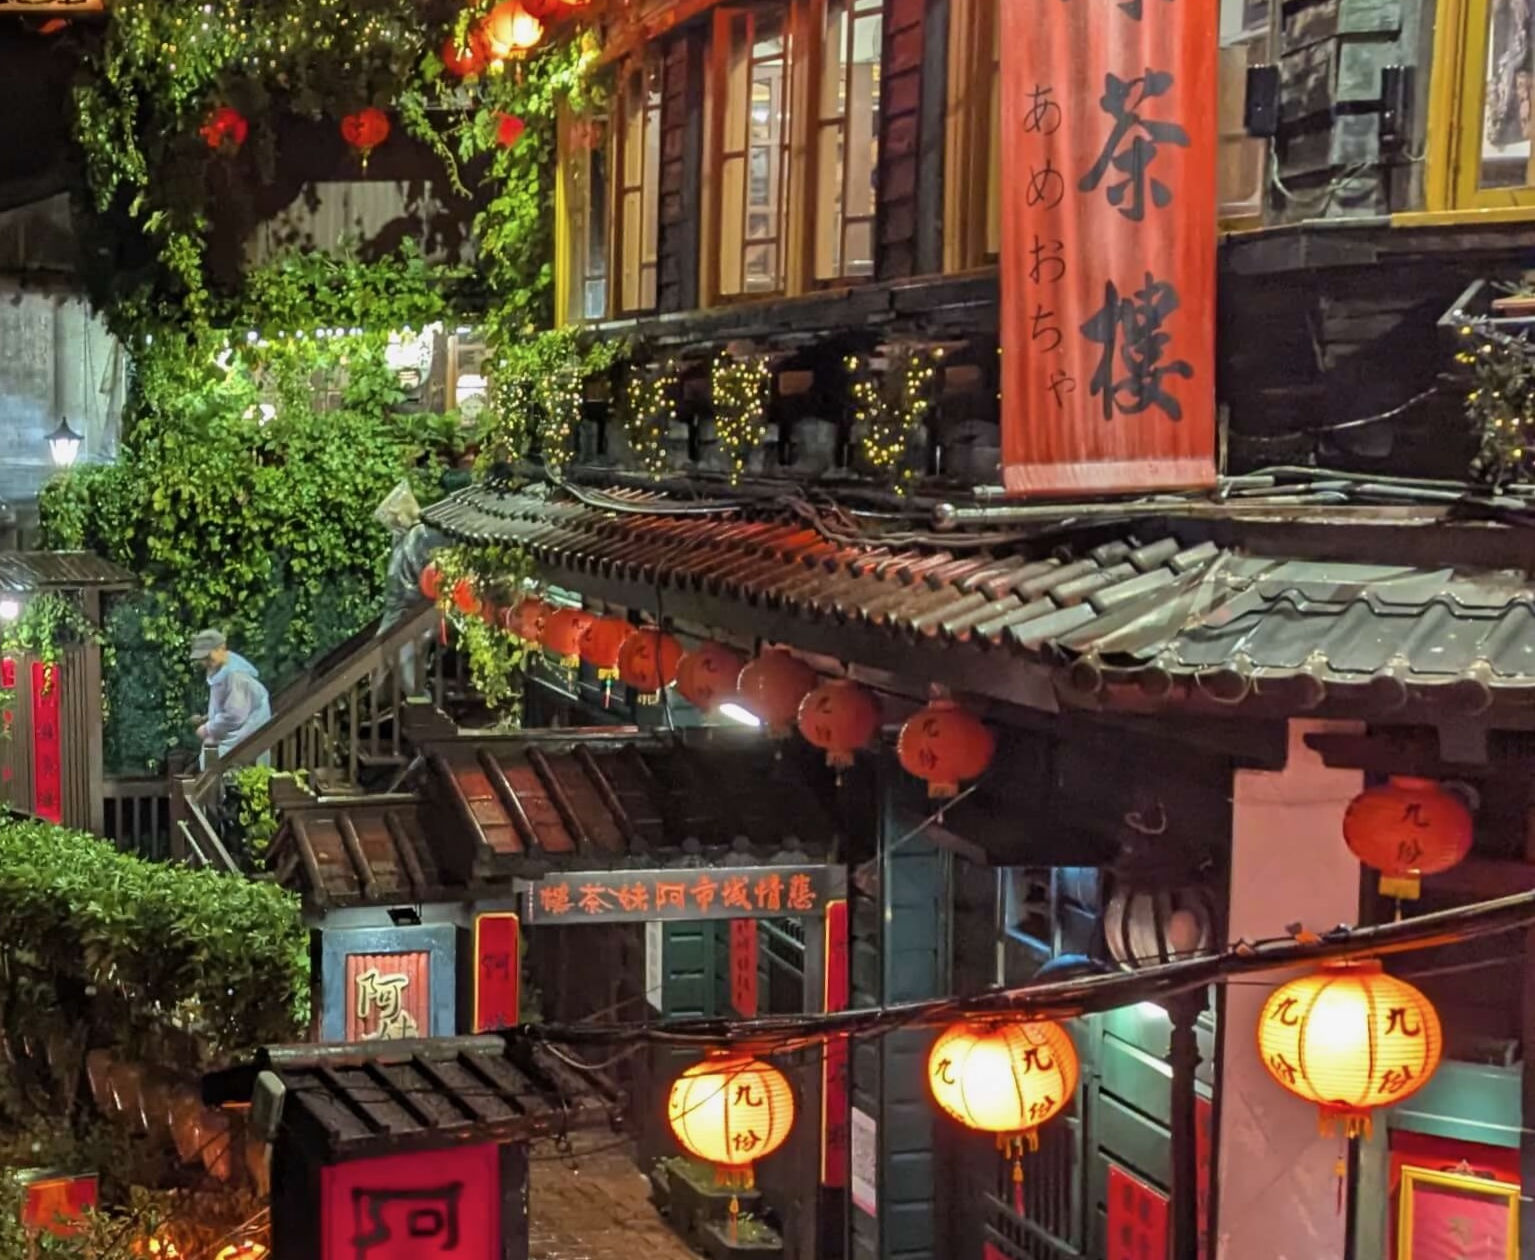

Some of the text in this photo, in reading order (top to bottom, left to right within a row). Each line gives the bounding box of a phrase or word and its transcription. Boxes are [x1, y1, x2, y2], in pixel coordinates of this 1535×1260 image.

[1022, 83, 1077, 409] あめおちゃ
[1397, 803, 1430, 865] 九份
[1270, 997, 1299, 1085] 九份
[1377, 1007, 1422, 1094] 九份
[733, 1085, 763, 1152] 九份
[1022, 1047, 1057, 1121] 九份
